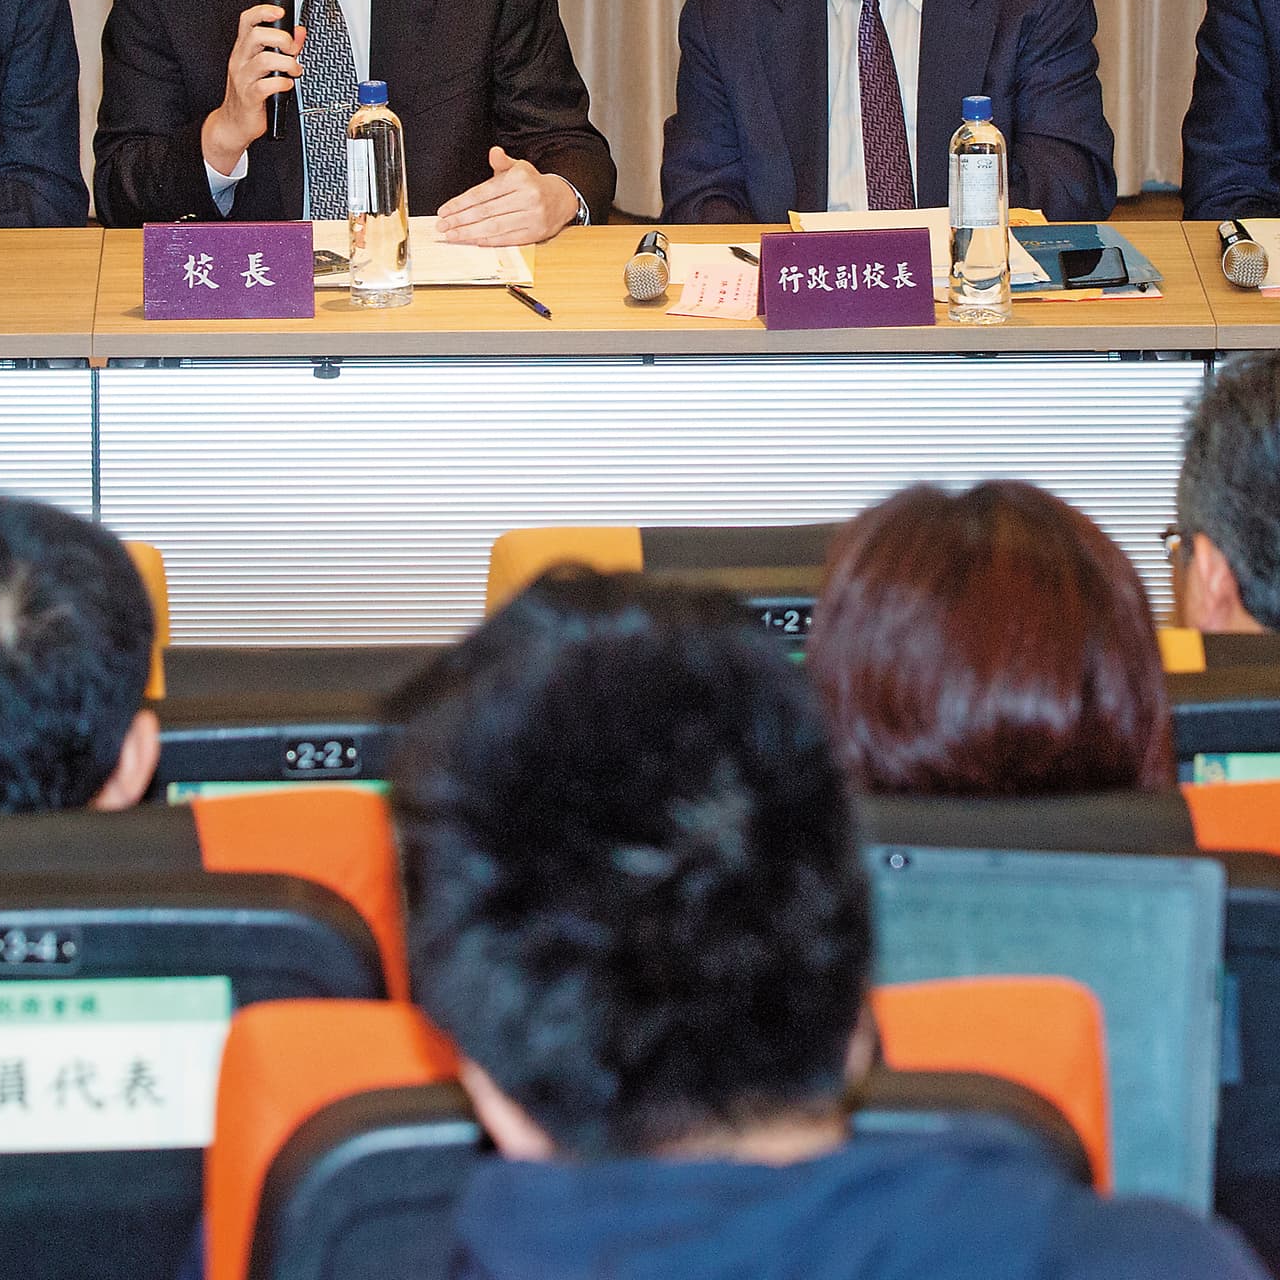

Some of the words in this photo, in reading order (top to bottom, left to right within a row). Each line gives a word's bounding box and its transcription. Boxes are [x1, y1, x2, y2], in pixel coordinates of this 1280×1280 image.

[183, 252, 276, 289] 校長
[778, 262, 918, 294] 行政副校長
[761, 609, 800, 632] 1-2
[296, 740, 343, 769] 2-2
[4, 928, 58, 964] 3-4
